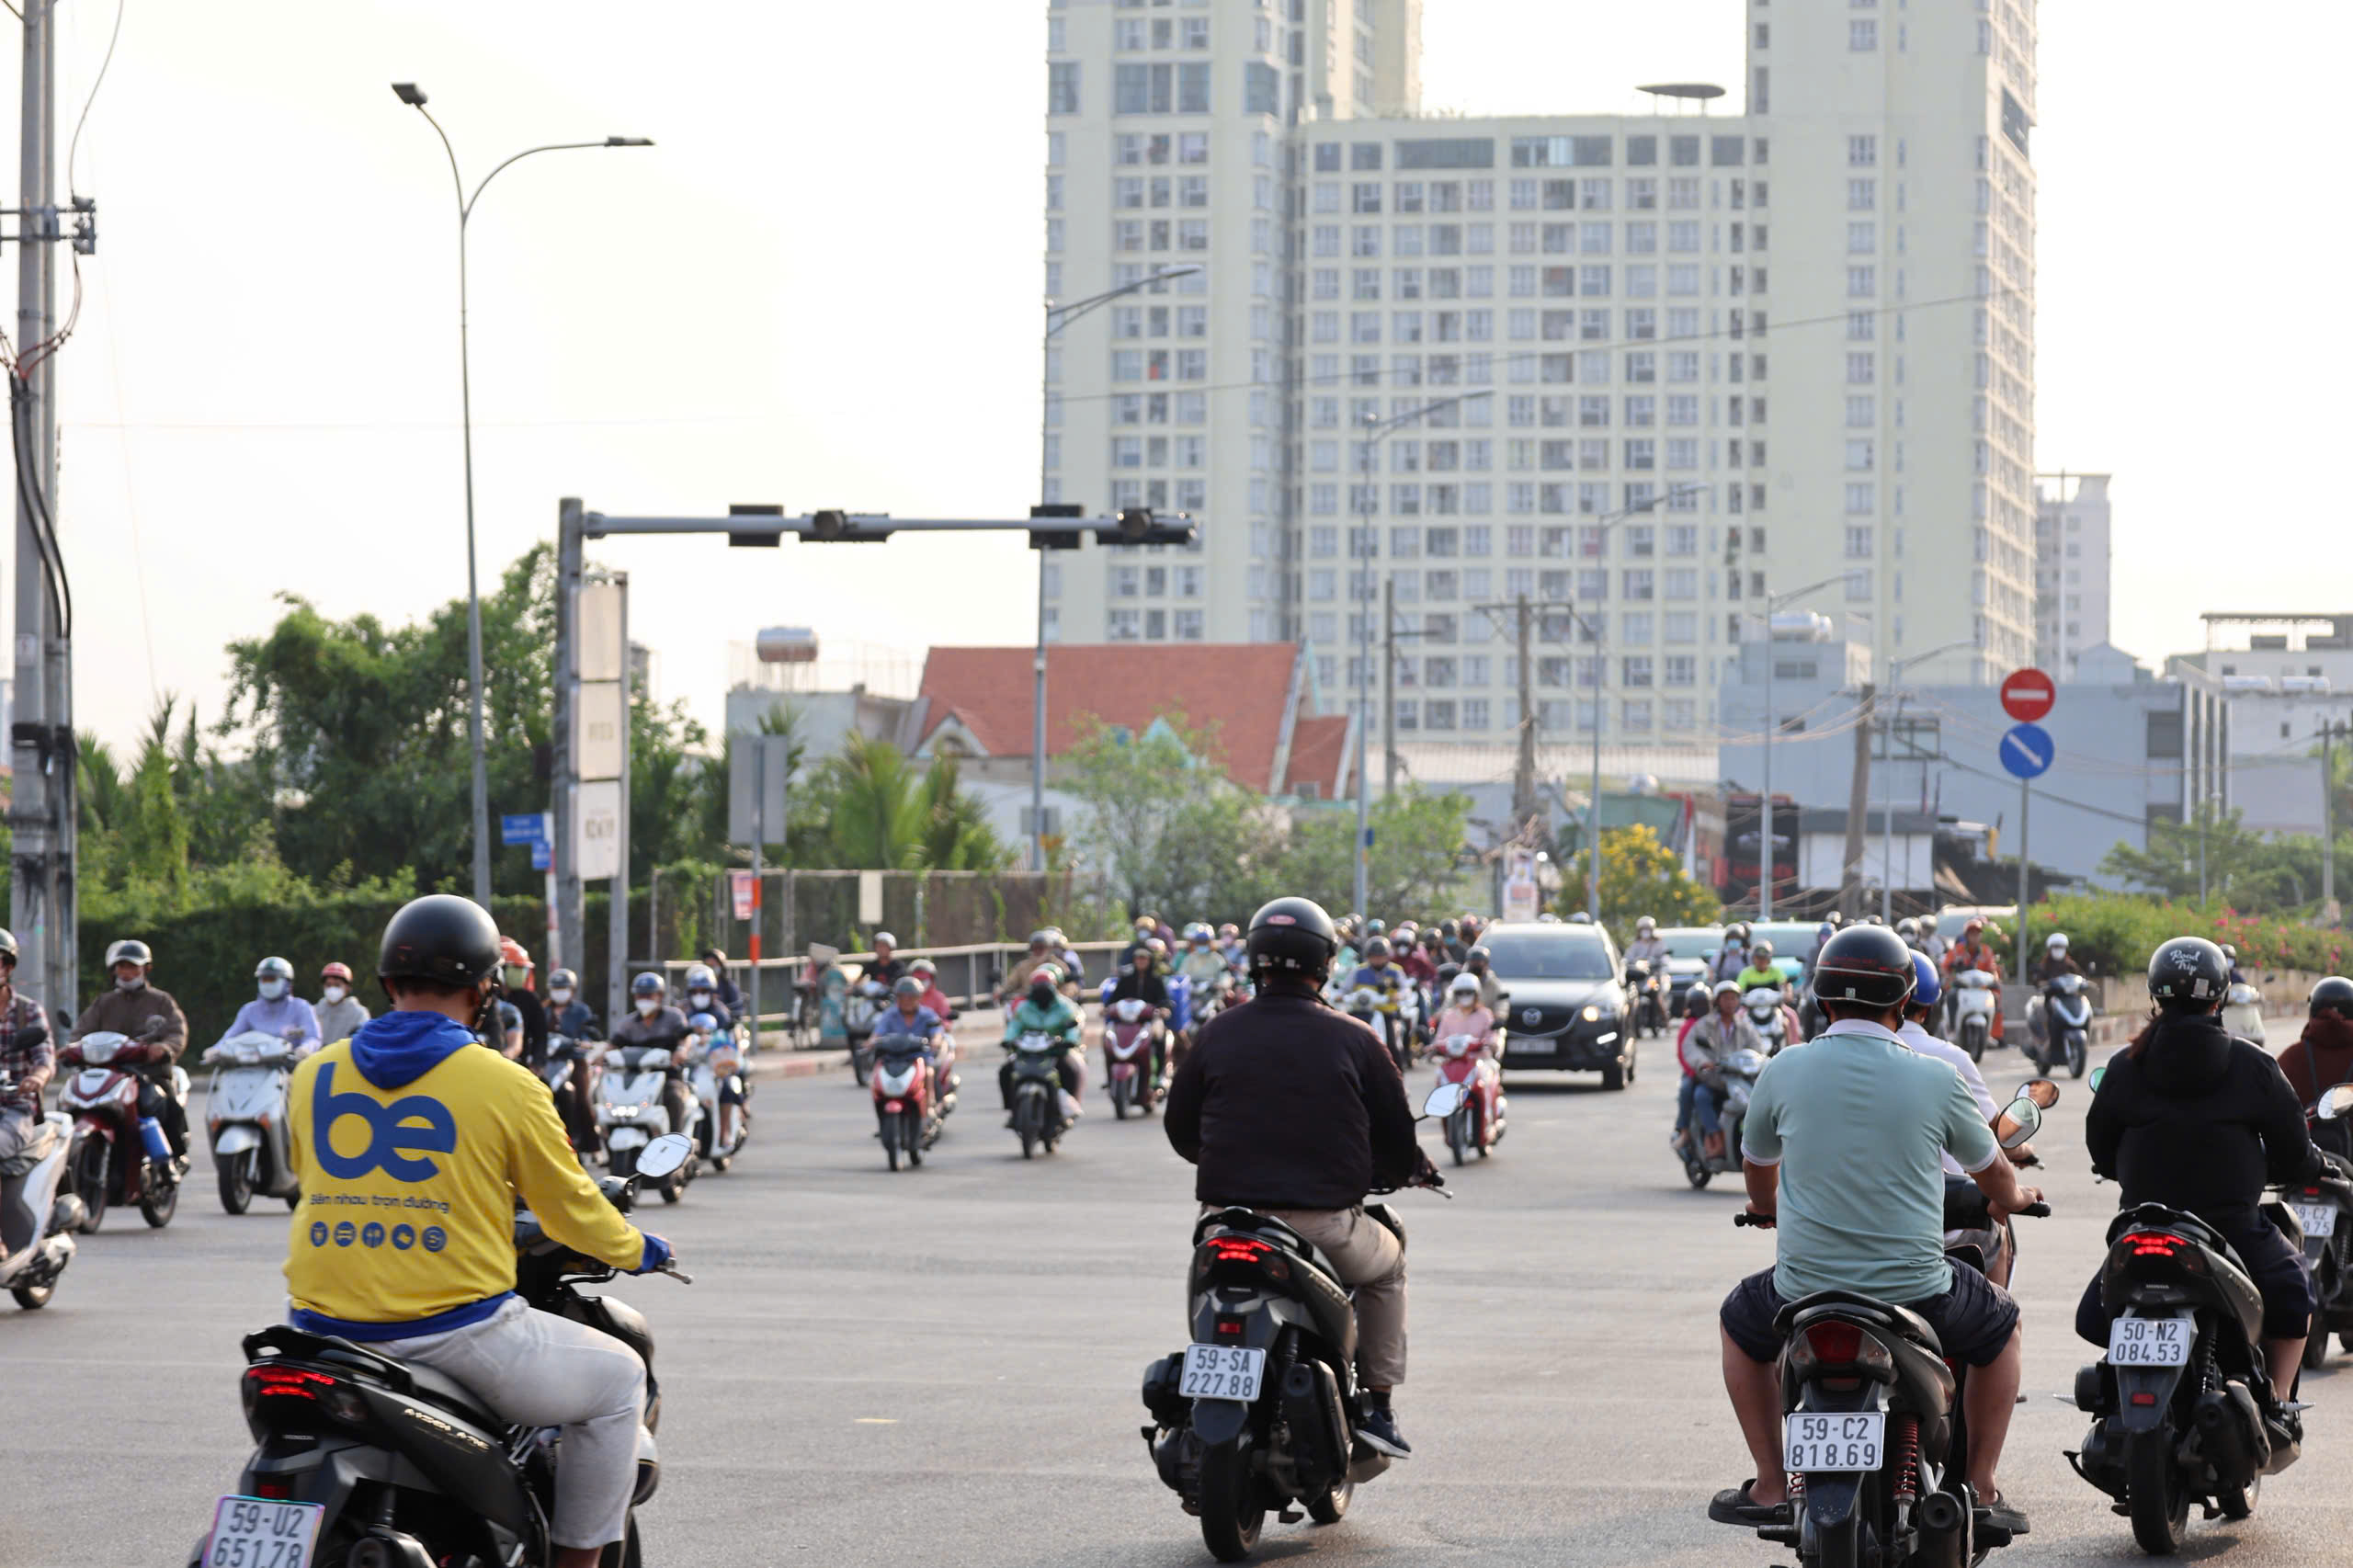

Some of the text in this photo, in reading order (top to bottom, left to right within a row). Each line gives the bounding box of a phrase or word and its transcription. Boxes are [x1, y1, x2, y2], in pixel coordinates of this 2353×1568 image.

[2170, 949, 2200, 961] Road
[2175, 959, 2197, 976] Trip
[313, 1062, 457, 1183] be
[2123, 1322, 2178, 1342] 50-N2
[1196, 1347, 1251, 1373] 59-SA
[2116, 1344, 2181, 1362] 084.53
[1187, 1372, 1254, 1398] 227.88
[1802, 1417, 1869, 1440] 59-C2
[1791, 1443, 1876, 1467] 818.69
[229, 1503, 304, 1539] 59-U2
